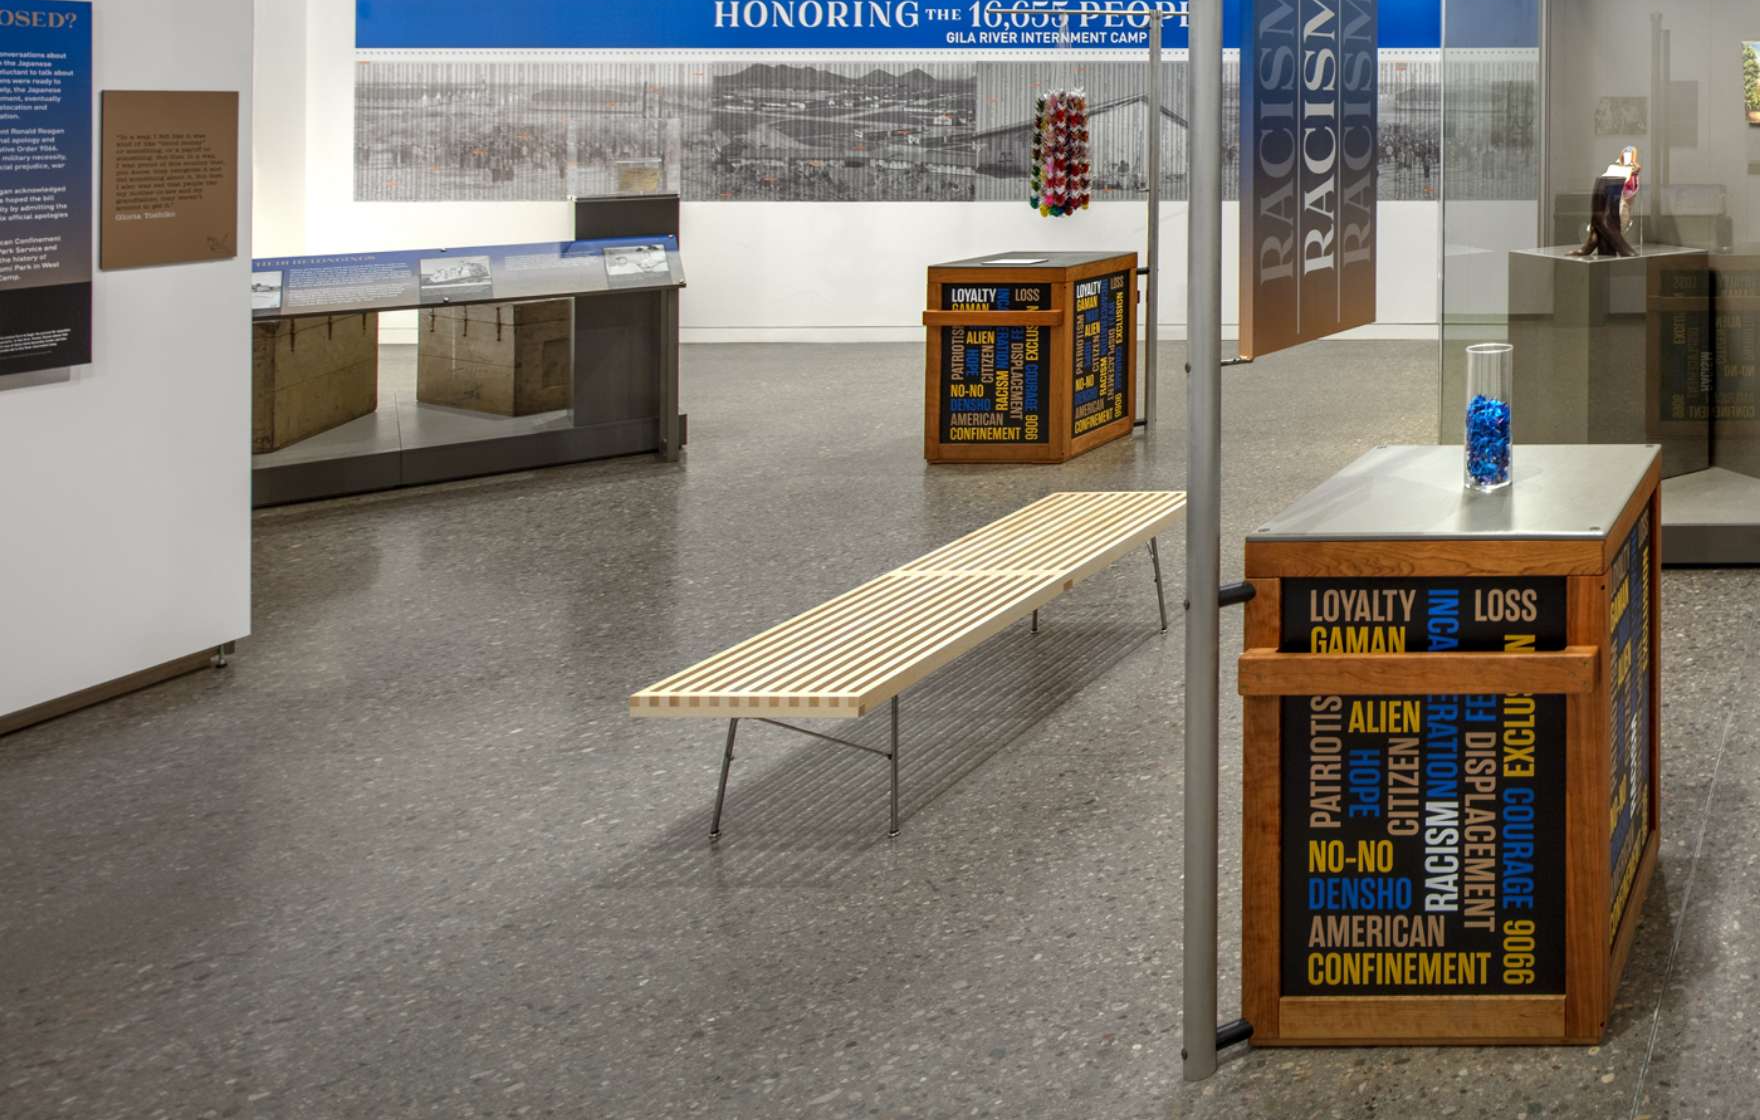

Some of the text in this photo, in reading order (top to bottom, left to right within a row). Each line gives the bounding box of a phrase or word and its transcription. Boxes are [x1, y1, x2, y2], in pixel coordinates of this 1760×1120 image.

[714, 0, 920, 28] HONORING
[925, 8, 962, 21] THE
[969, 0, 1069, 32] 16,655
[946, 31, 1148, 44] GILA RIVER INTERNMENT CAMP
[951, 288, 997, 303] LOYALTY
[1015, 288, 1040, 302] LOSS
[951, 326, 964, 381] PATRIOTIS
[966, 330, 995, 344] ALIEN
[981, 345, 994, 383] CITIZEN
[1010, 342, 1023, 420] DISPLACEMENT
[950, 384, 984, 397] NO-NO
[995, 370, 1009, 411] RACISM
[950, 412, 1004, 426] AMERICAN
[950, 427, 1021, 441] CONFINEMENT
[1310, 589, 1417, 622] LOYALTY
[1474, 588, 1538, 622] LOSS
[1310, 625, 1406, 654] GAMAN
[1348, 700, 1421, 733] ALIEN
[1503, 634, 1536, 777] EXCLUN
[1310, 695, 1343, 828] PATRIOTIS
[1348, 749, 1381, 817] HOPE
[1387, 737, 1420, 836] CITIZEN
[1464, 732, 1497, 932] DISPLACEMENT
[1502, 787, 1535, 909] COURAGE
[1308, 839, 1394, 873] NO-NO
[1424, 801, 1459, 911] RACISM
[1308, 877, 1412, 910] DENSHO
[1308, 914, 1445, 948] AMERICAN
[1308, 952, 1492, 985] CONFINEMENT
[1503, 919, 1536, 985] 9066
